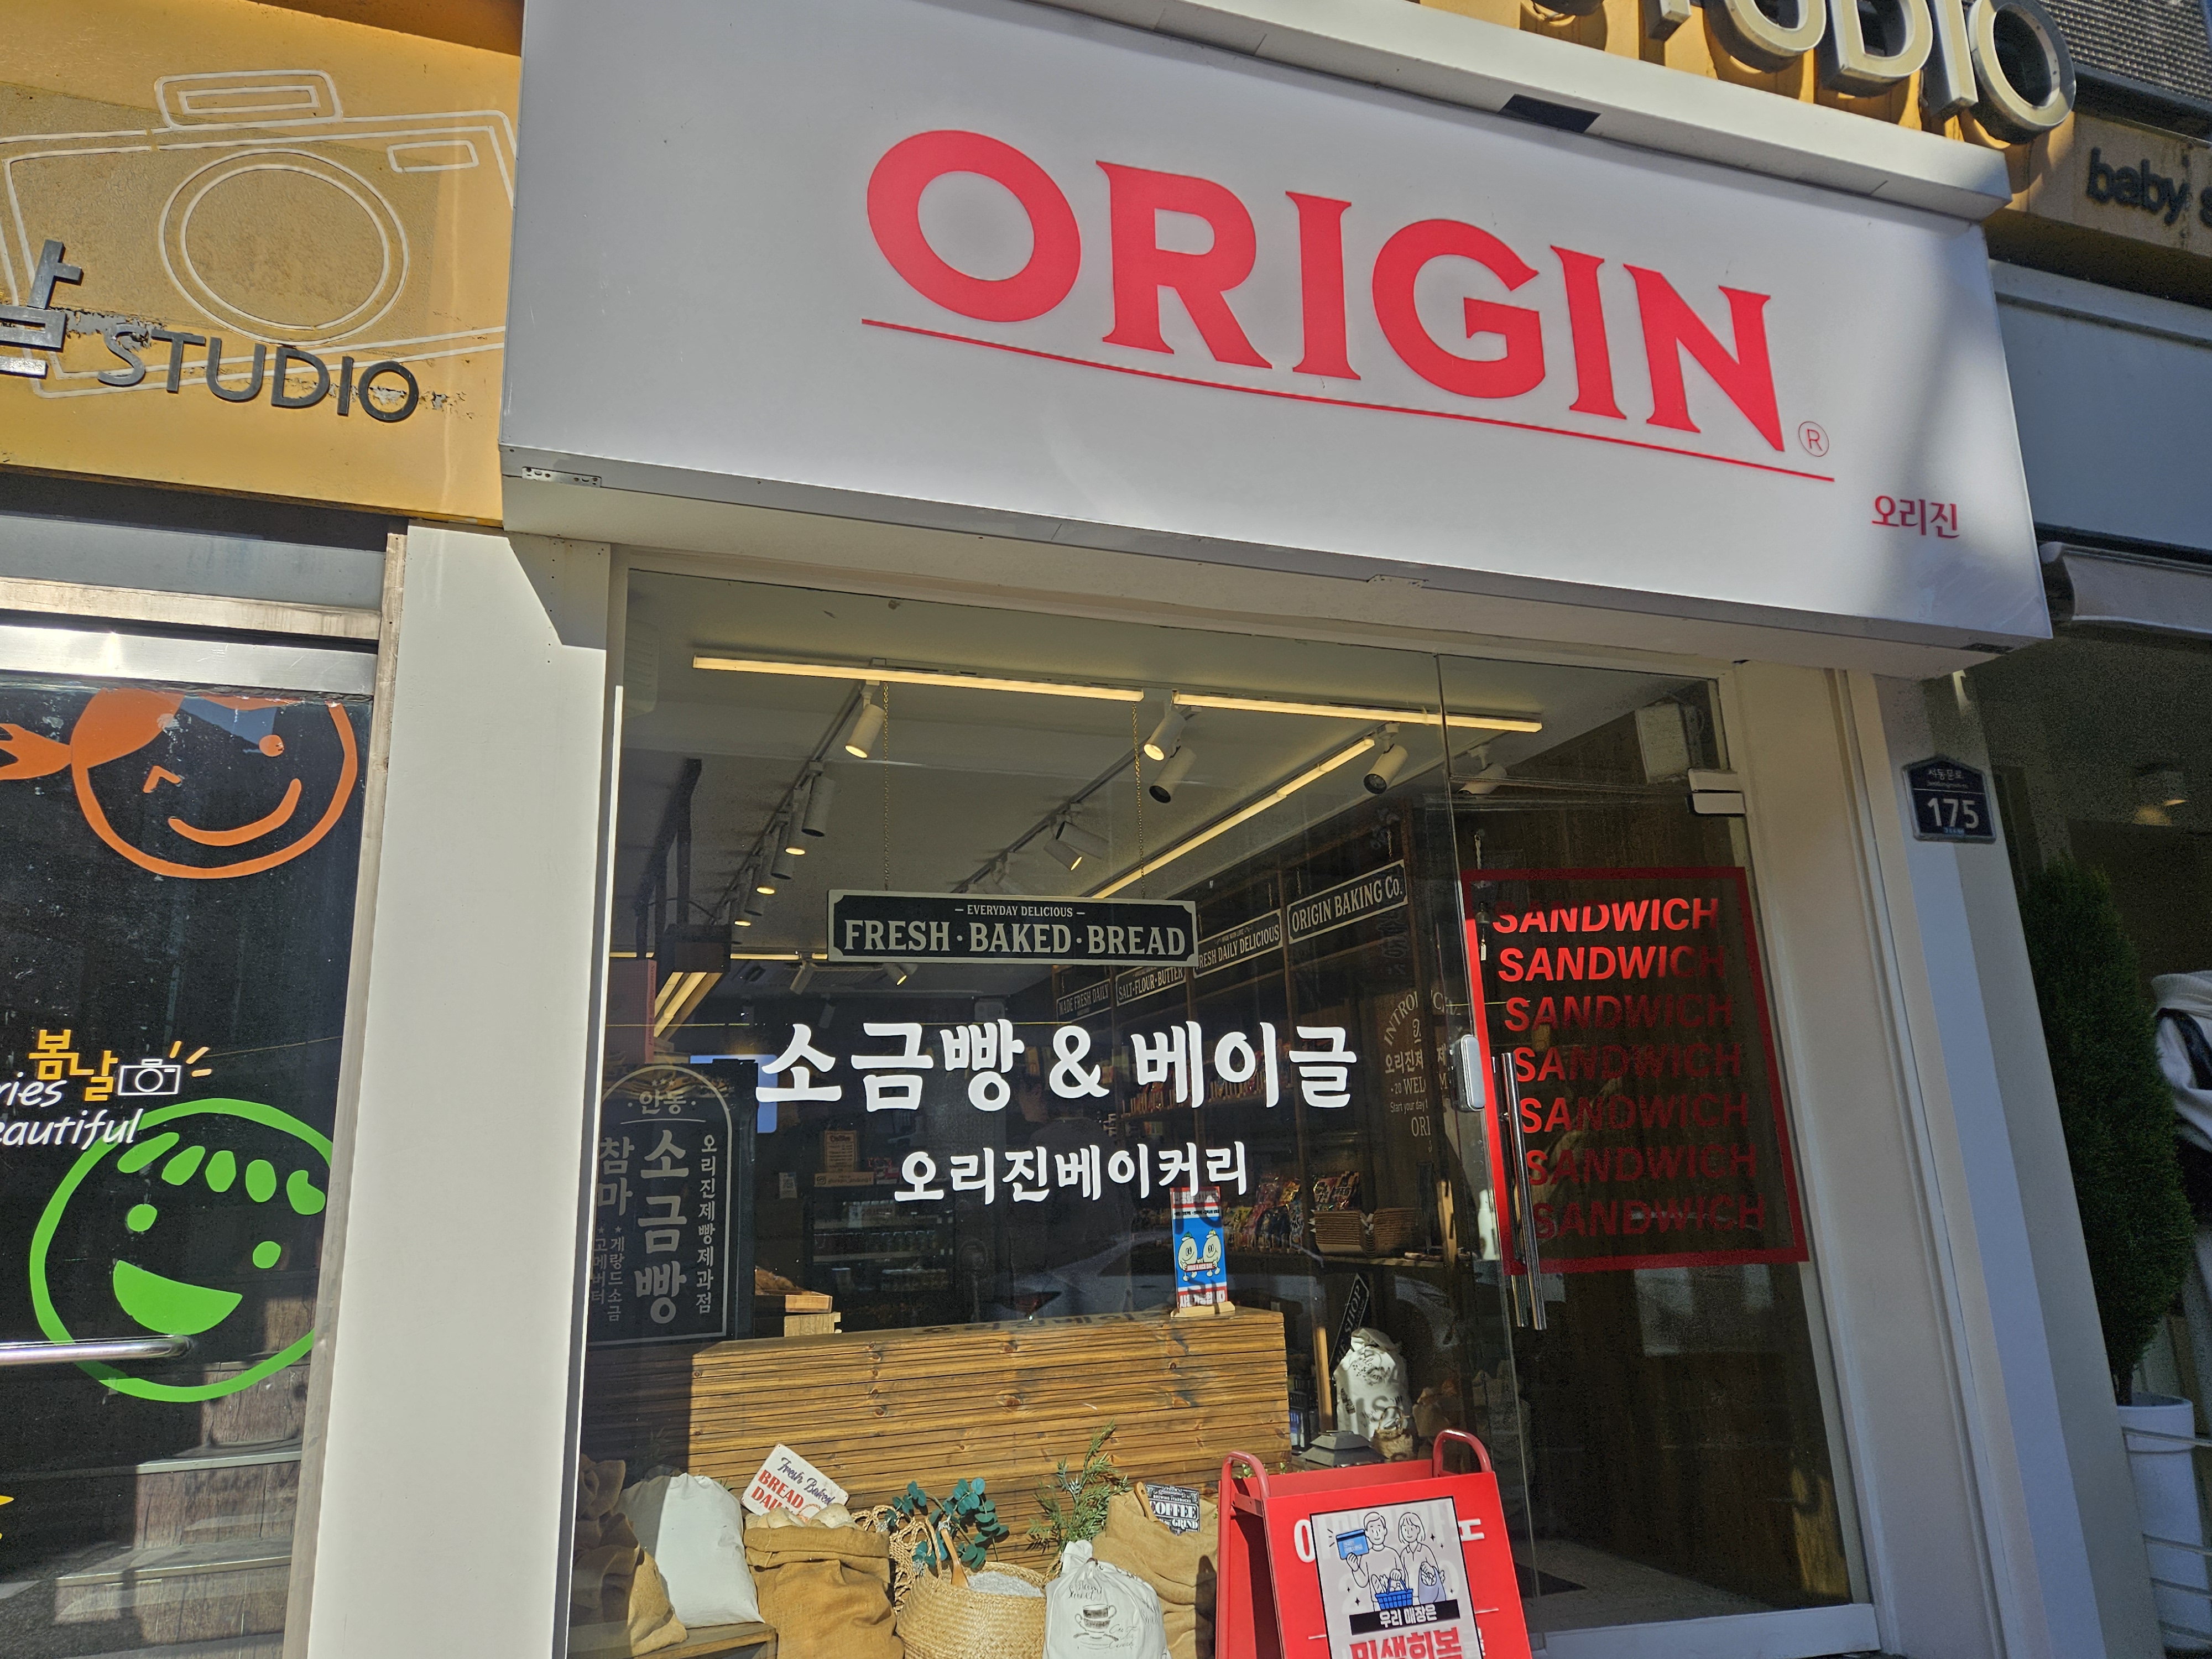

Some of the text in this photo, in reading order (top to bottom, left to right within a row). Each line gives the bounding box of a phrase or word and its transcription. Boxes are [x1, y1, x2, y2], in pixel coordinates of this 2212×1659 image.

[2086, 147, 2190, 226] baby
[867, 129, 1785, 452] ORIGIN
[97, 323, 419, 424] STUDIO
[1871, 495, 1960, 539] 오리진
[1927, 797, 1979, 829] 175
[967, 904, 1073, 918] EVERYDAY DELICIOUS
[1292, 898, 1332, 933] ORIGIN
[1334, 880, 1383, 918] BAKING
[1493, 898, 1719, 933] SANDWICH
[844, 919, 1186, 956] FRESH BAKED BREAD
[1196, 924, 1280, 969] RESH DAILY DELICIOUS
[1498, 945, 1725, 982] SANDWICH
[1074, 990, 1092, 1010] FRESH
[1092, 983, 1109, 1003] DAILY
[1504, 994, 1734, 1031] SANDWICH
[28, 1029, 118, 1102] 봄날
[755, 1018, 1357, 1112] 소금빵 & 베이글
[1515, 1044, 1742, 1082] SANDWICH
[639, 1088, 687, 1115] 안동
[1521, 1093, 1750, 1134] SANDWICH
[0, 1108, 144, 1150] autiful
[597, 1136, 635, 1217] 참마
[894, 1141, 1247, 1204] 오리진베이커리
[1527, 1144, 1758, 1186] SANDWICH
[634, 1129, 690, 1324] 소금빵
[696, 1134, 718, 1315] 오리진제빵제과점
[1532, 1194, 1766, 1239] SANDWICH
[607, 1236, 625, 1322] 게랑드소금
[758, 1469, 804, 1509] BREAD
[777, 1457, 836, 1505] Fresh Baked
[1379, 1604, 1438, 1628] 우리 매장은
